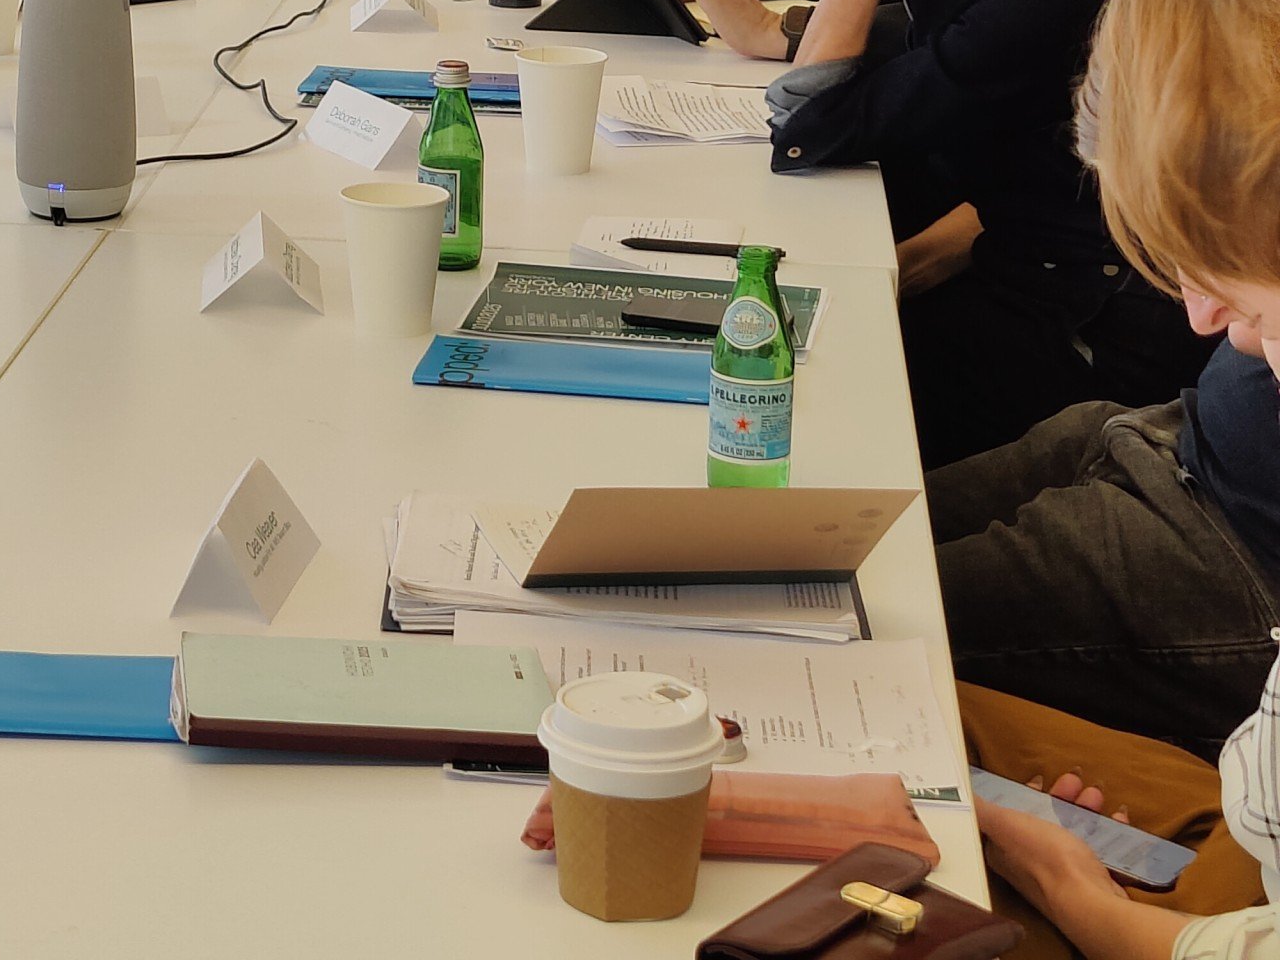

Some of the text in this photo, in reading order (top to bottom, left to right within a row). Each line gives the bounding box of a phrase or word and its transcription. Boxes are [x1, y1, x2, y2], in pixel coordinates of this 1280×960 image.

[330, 105, 360, 127] Deborah
[246, 511, 278, 559] Cea Weaver
